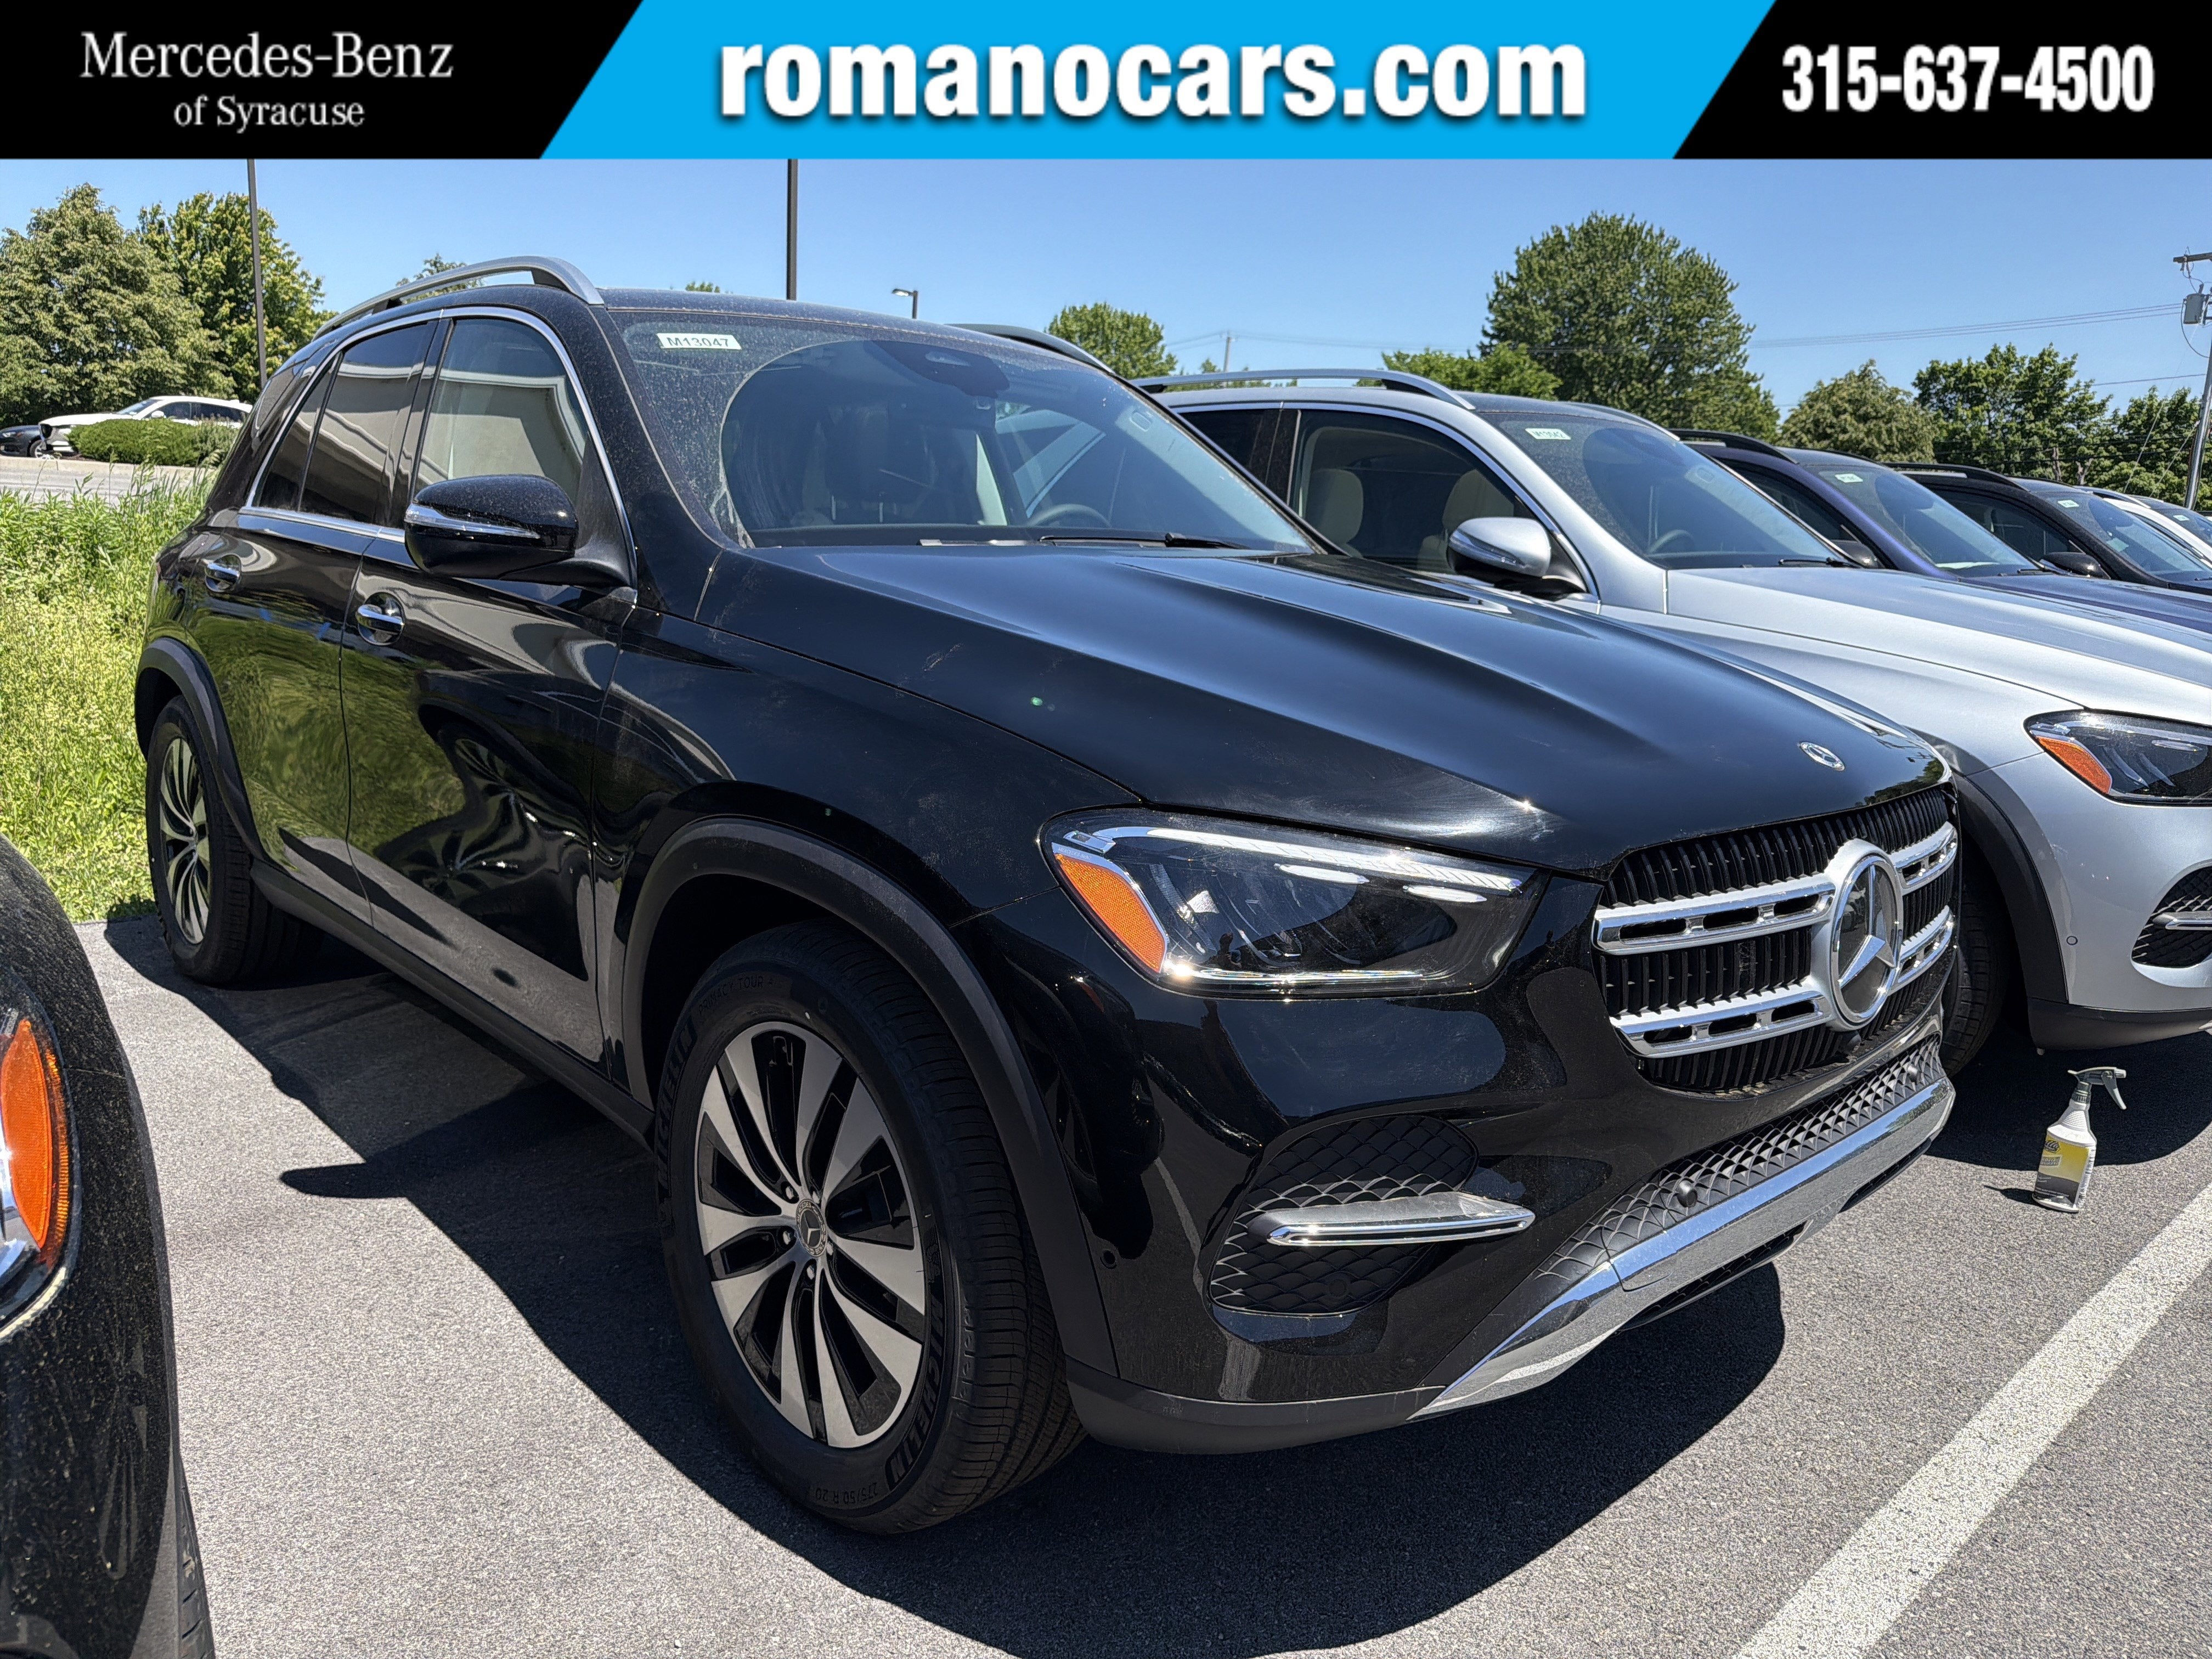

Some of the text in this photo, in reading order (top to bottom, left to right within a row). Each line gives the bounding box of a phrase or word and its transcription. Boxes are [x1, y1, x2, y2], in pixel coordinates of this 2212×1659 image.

[665, 336, 729, 347] M13047
[738, 976, 764, 990] TOUR
[889, 1294, 944, 1483] MICHELIN
[815, 1488, 828, 1502] 20
